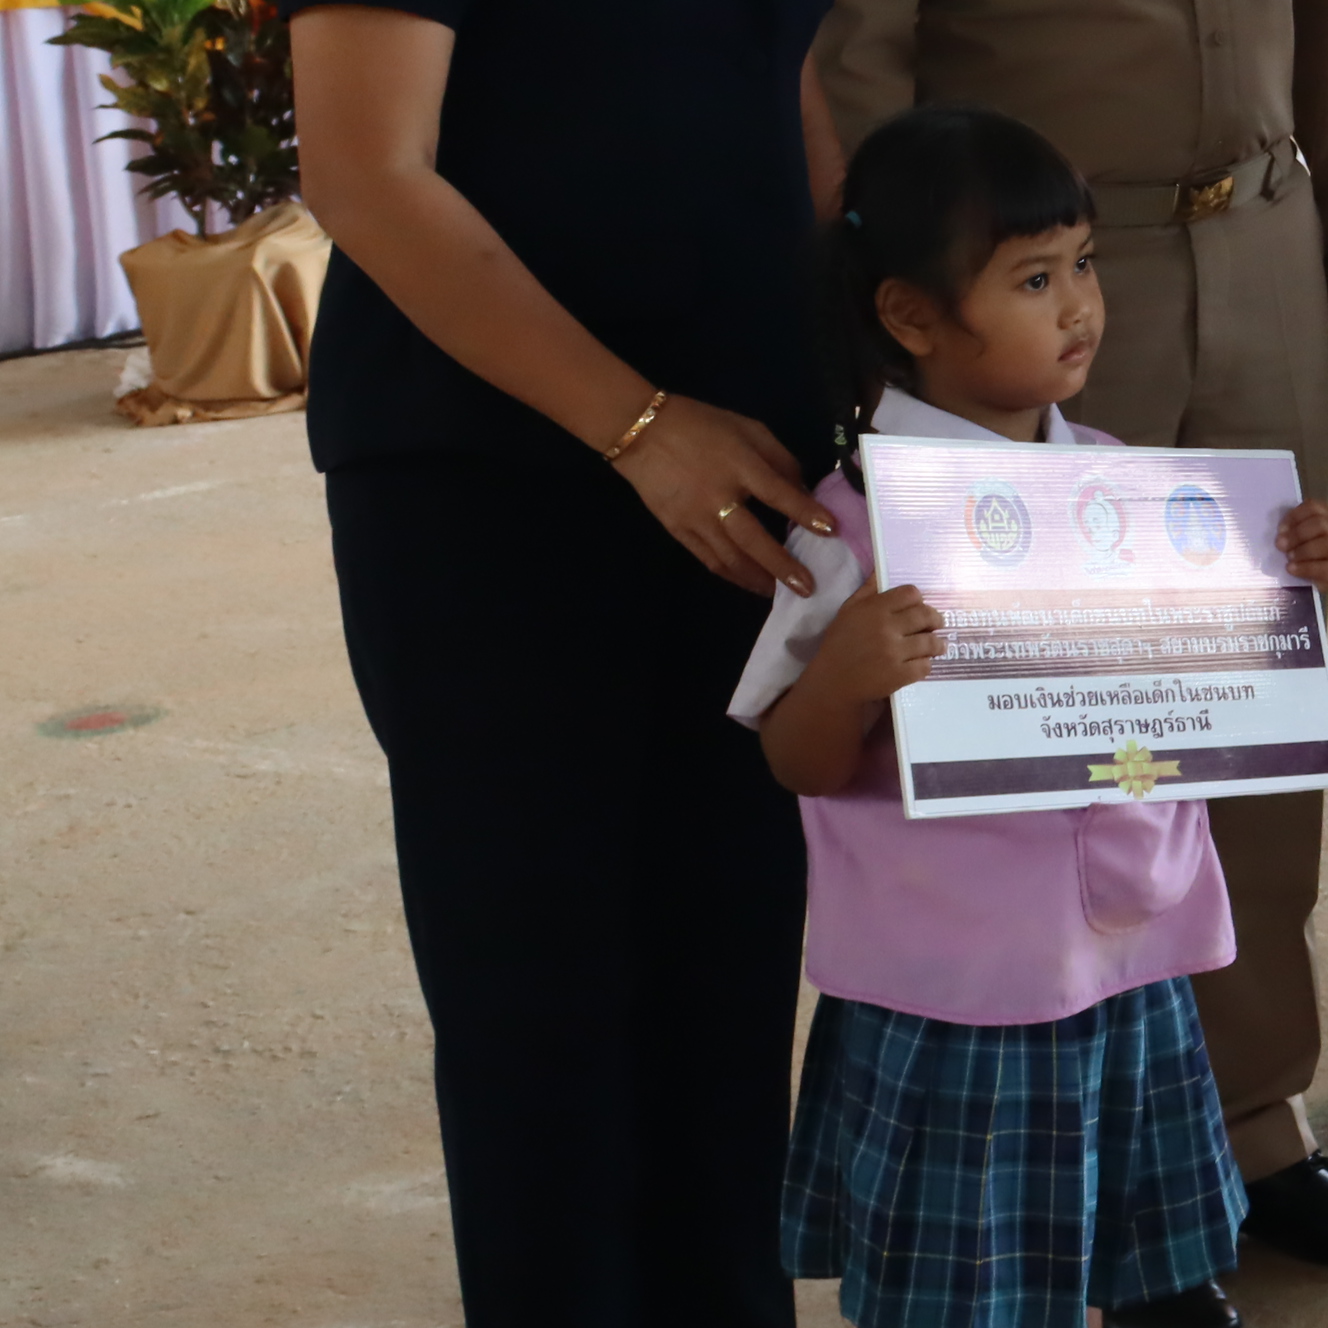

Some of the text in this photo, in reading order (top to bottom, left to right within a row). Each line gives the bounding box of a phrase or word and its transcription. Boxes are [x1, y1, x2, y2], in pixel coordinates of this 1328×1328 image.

[930, 631, 1153, 665] ด็จพระเทพรัตนราชสุดาฯ
[987, 679, 1256, 713] มอบเงินช่วยเหลือเด็กในชนบท
[1039, 709, 1213, 745] จังหวัดสุราษฎร์ธานี
